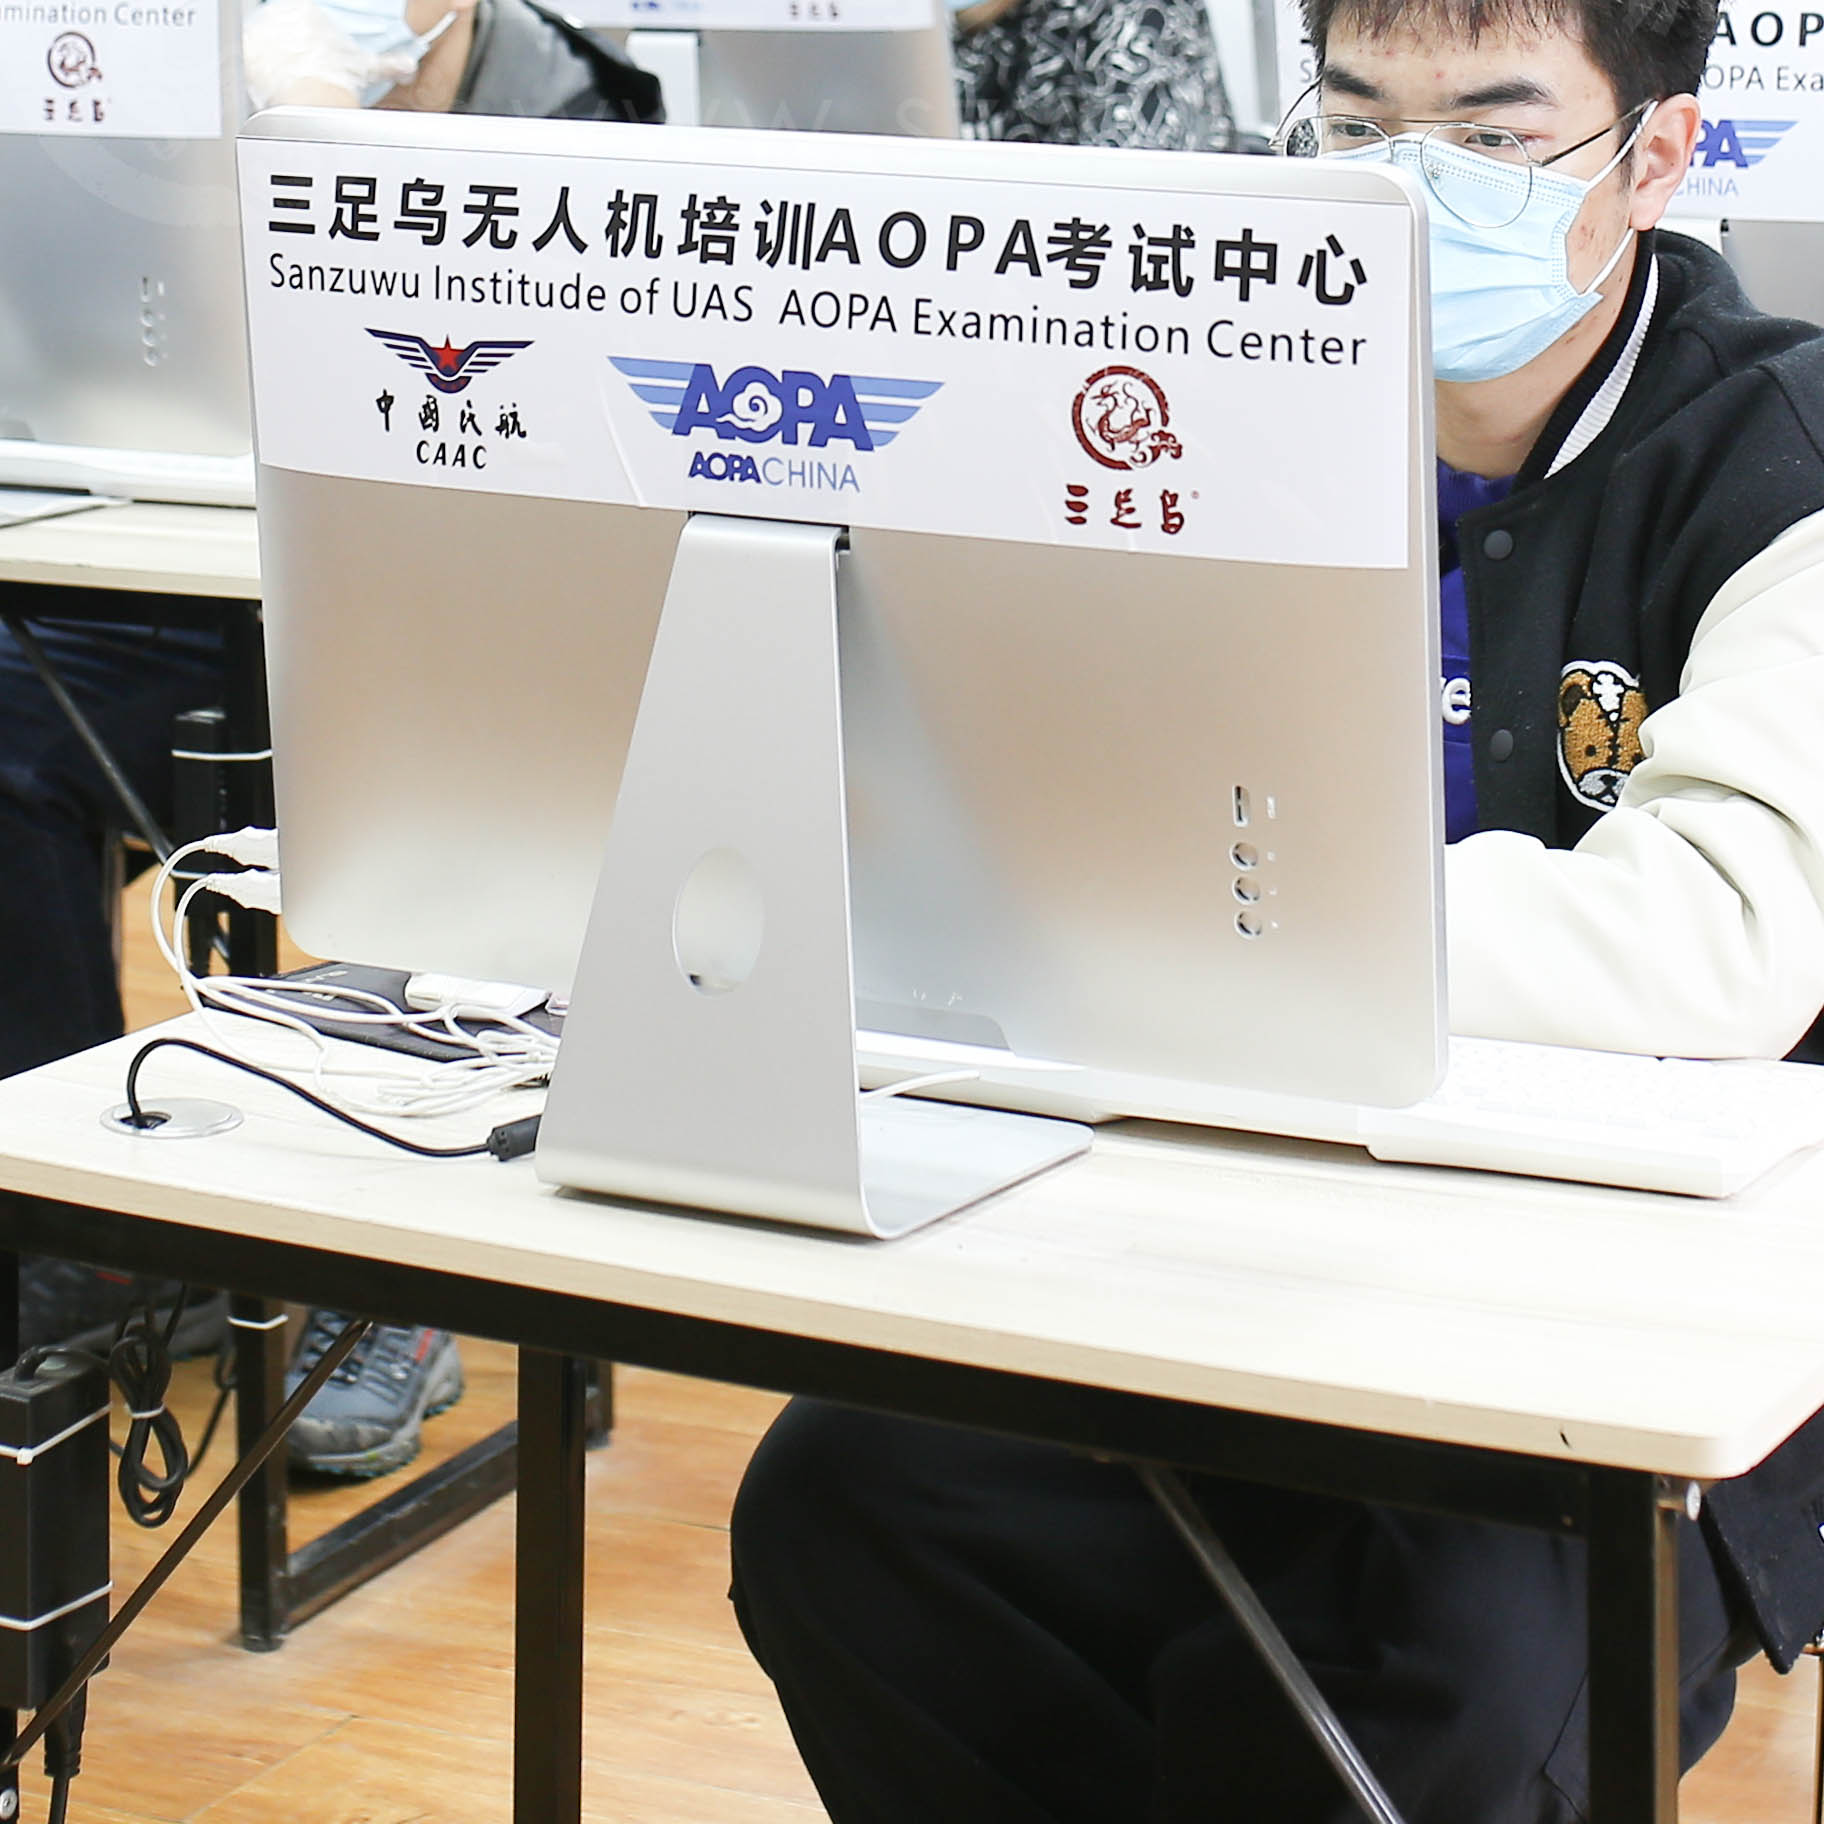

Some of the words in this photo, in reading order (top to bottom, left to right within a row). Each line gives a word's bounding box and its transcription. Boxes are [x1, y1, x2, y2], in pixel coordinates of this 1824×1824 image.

[114, 2, 197, 28] Center
[1698, 64, 1765, 92] OPA
[267, 173, 1369, 307] 三足乌无人机培训AOPA考试中心
[269, 252, 420, 300] Sanzuwu
[434, 265, 607, 313] Institude
[619, 276, 659, 315] of
[672, 281, 754, 324] UAS
[778, 288, 898, 334] AOPA
[913, 297, 1191, 357] Examination
[1206, 318, 1369, 367] Center
[671, 361, 876, 453] AOPA
[416, 439, 489, 470] CAAC
[1440, 676, 1473, 726] e
